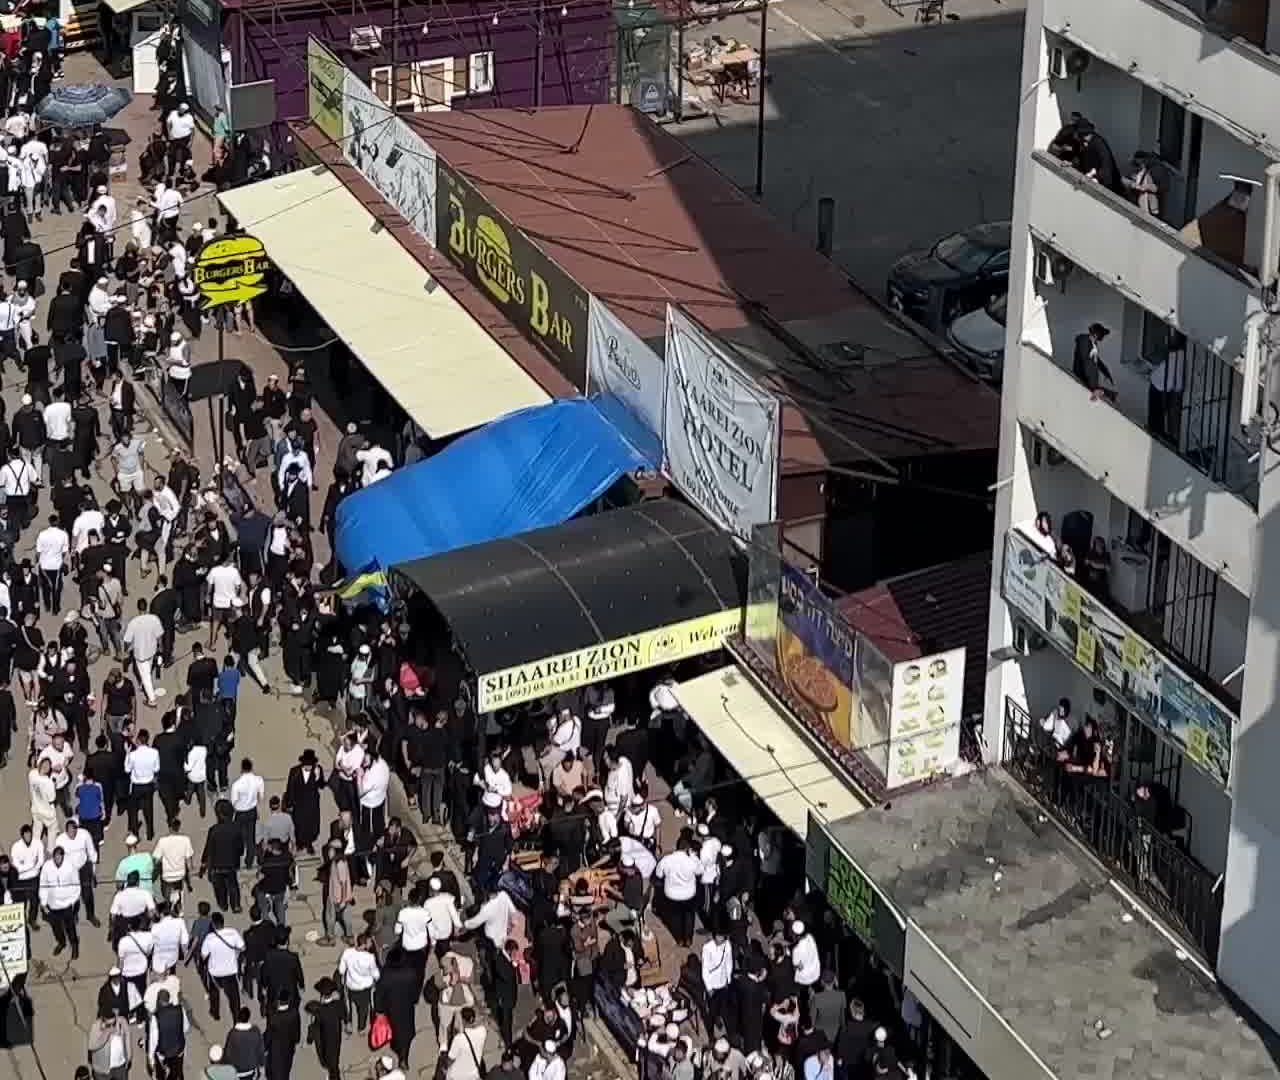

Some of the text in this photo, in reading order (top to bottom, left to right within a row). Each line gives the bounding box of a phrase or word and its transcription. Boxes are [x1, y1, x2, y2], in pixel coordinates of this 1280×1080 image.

[194, 259, 270, 284] BURGERS BAR
[448, 192, 573, 353] BURGERS BAR
[675, 369, 730, 434] SHAAREI
[731, 426, 765, 465] ZION
[684, 412, 754, 493] HOTEL
[486, 656, 582, 694] SHAAREI
[586, 639, 641, 665] ZION
[584, 655, 641, 680] HOTEL
